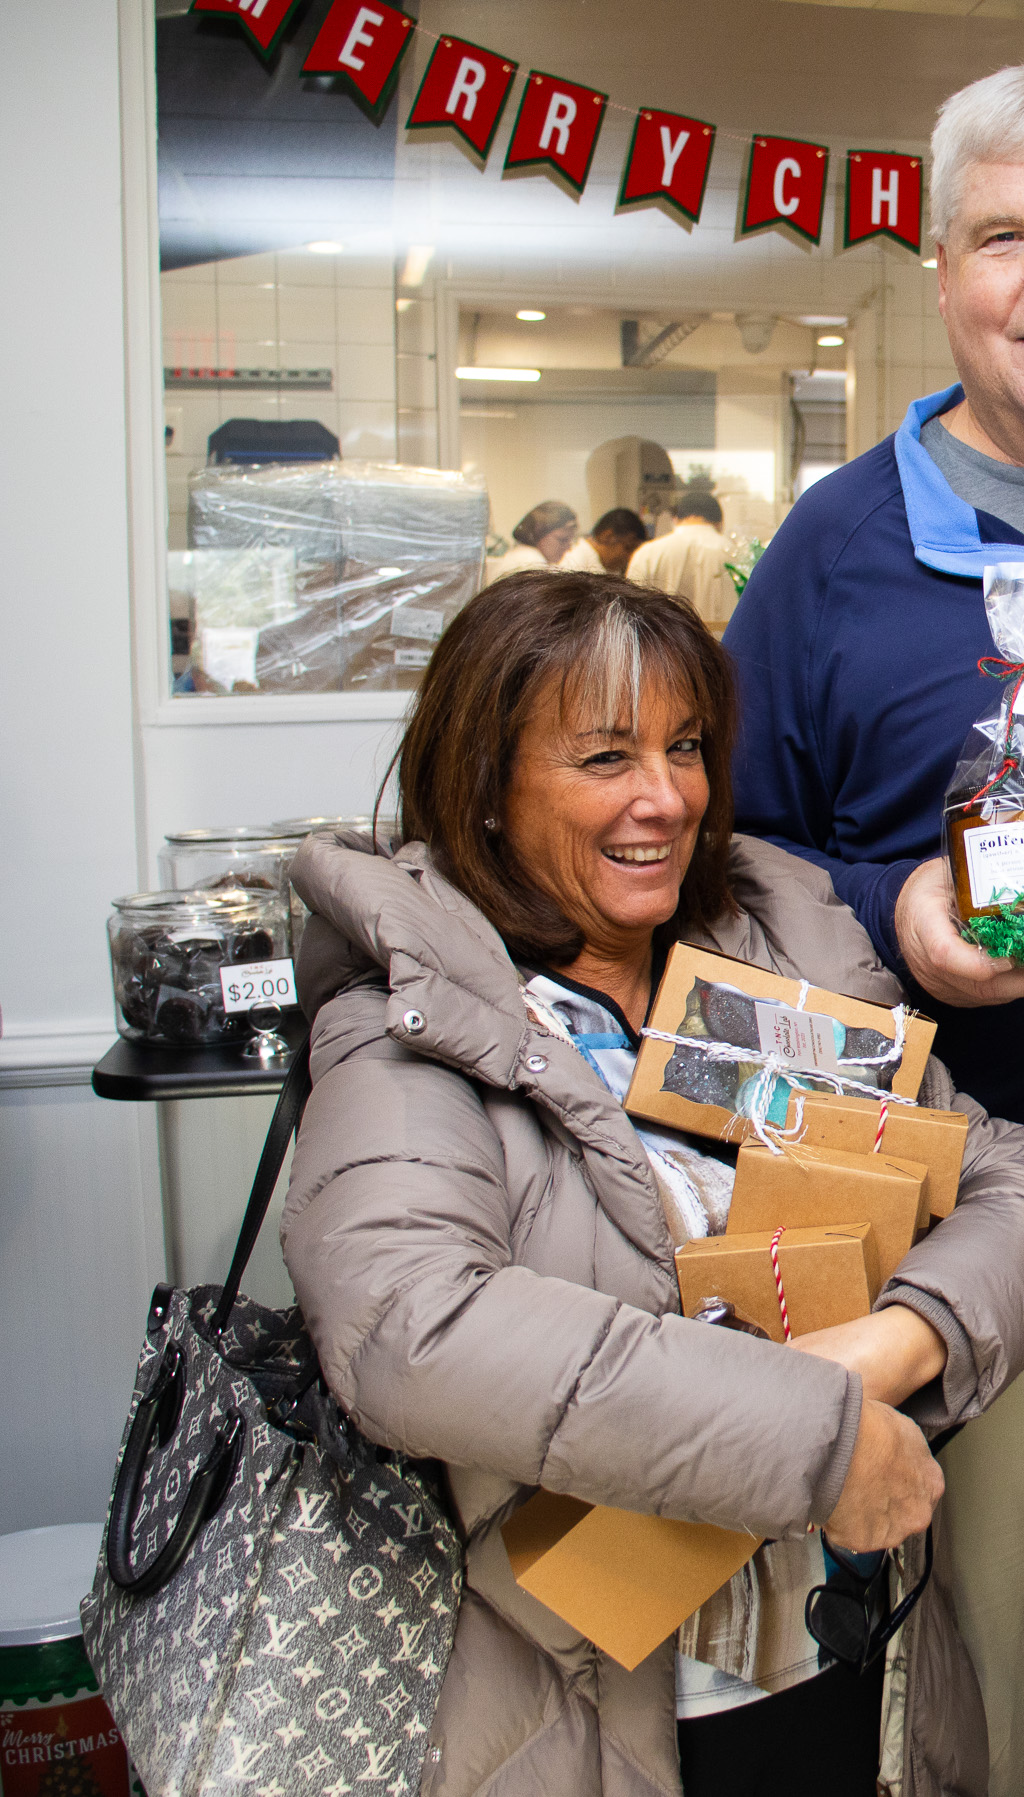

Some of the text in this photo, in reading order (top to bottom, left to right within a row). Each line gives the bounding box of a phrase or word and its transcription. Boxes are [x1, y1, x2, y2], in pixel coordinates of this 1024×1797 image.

[226, 0, 690, 187] ERRY
[228, 978, 290, 1003] $2.00
[3, 1728, 55, 1748] Merry
[5, 1728, 120, 1765] CHRISTMAS
